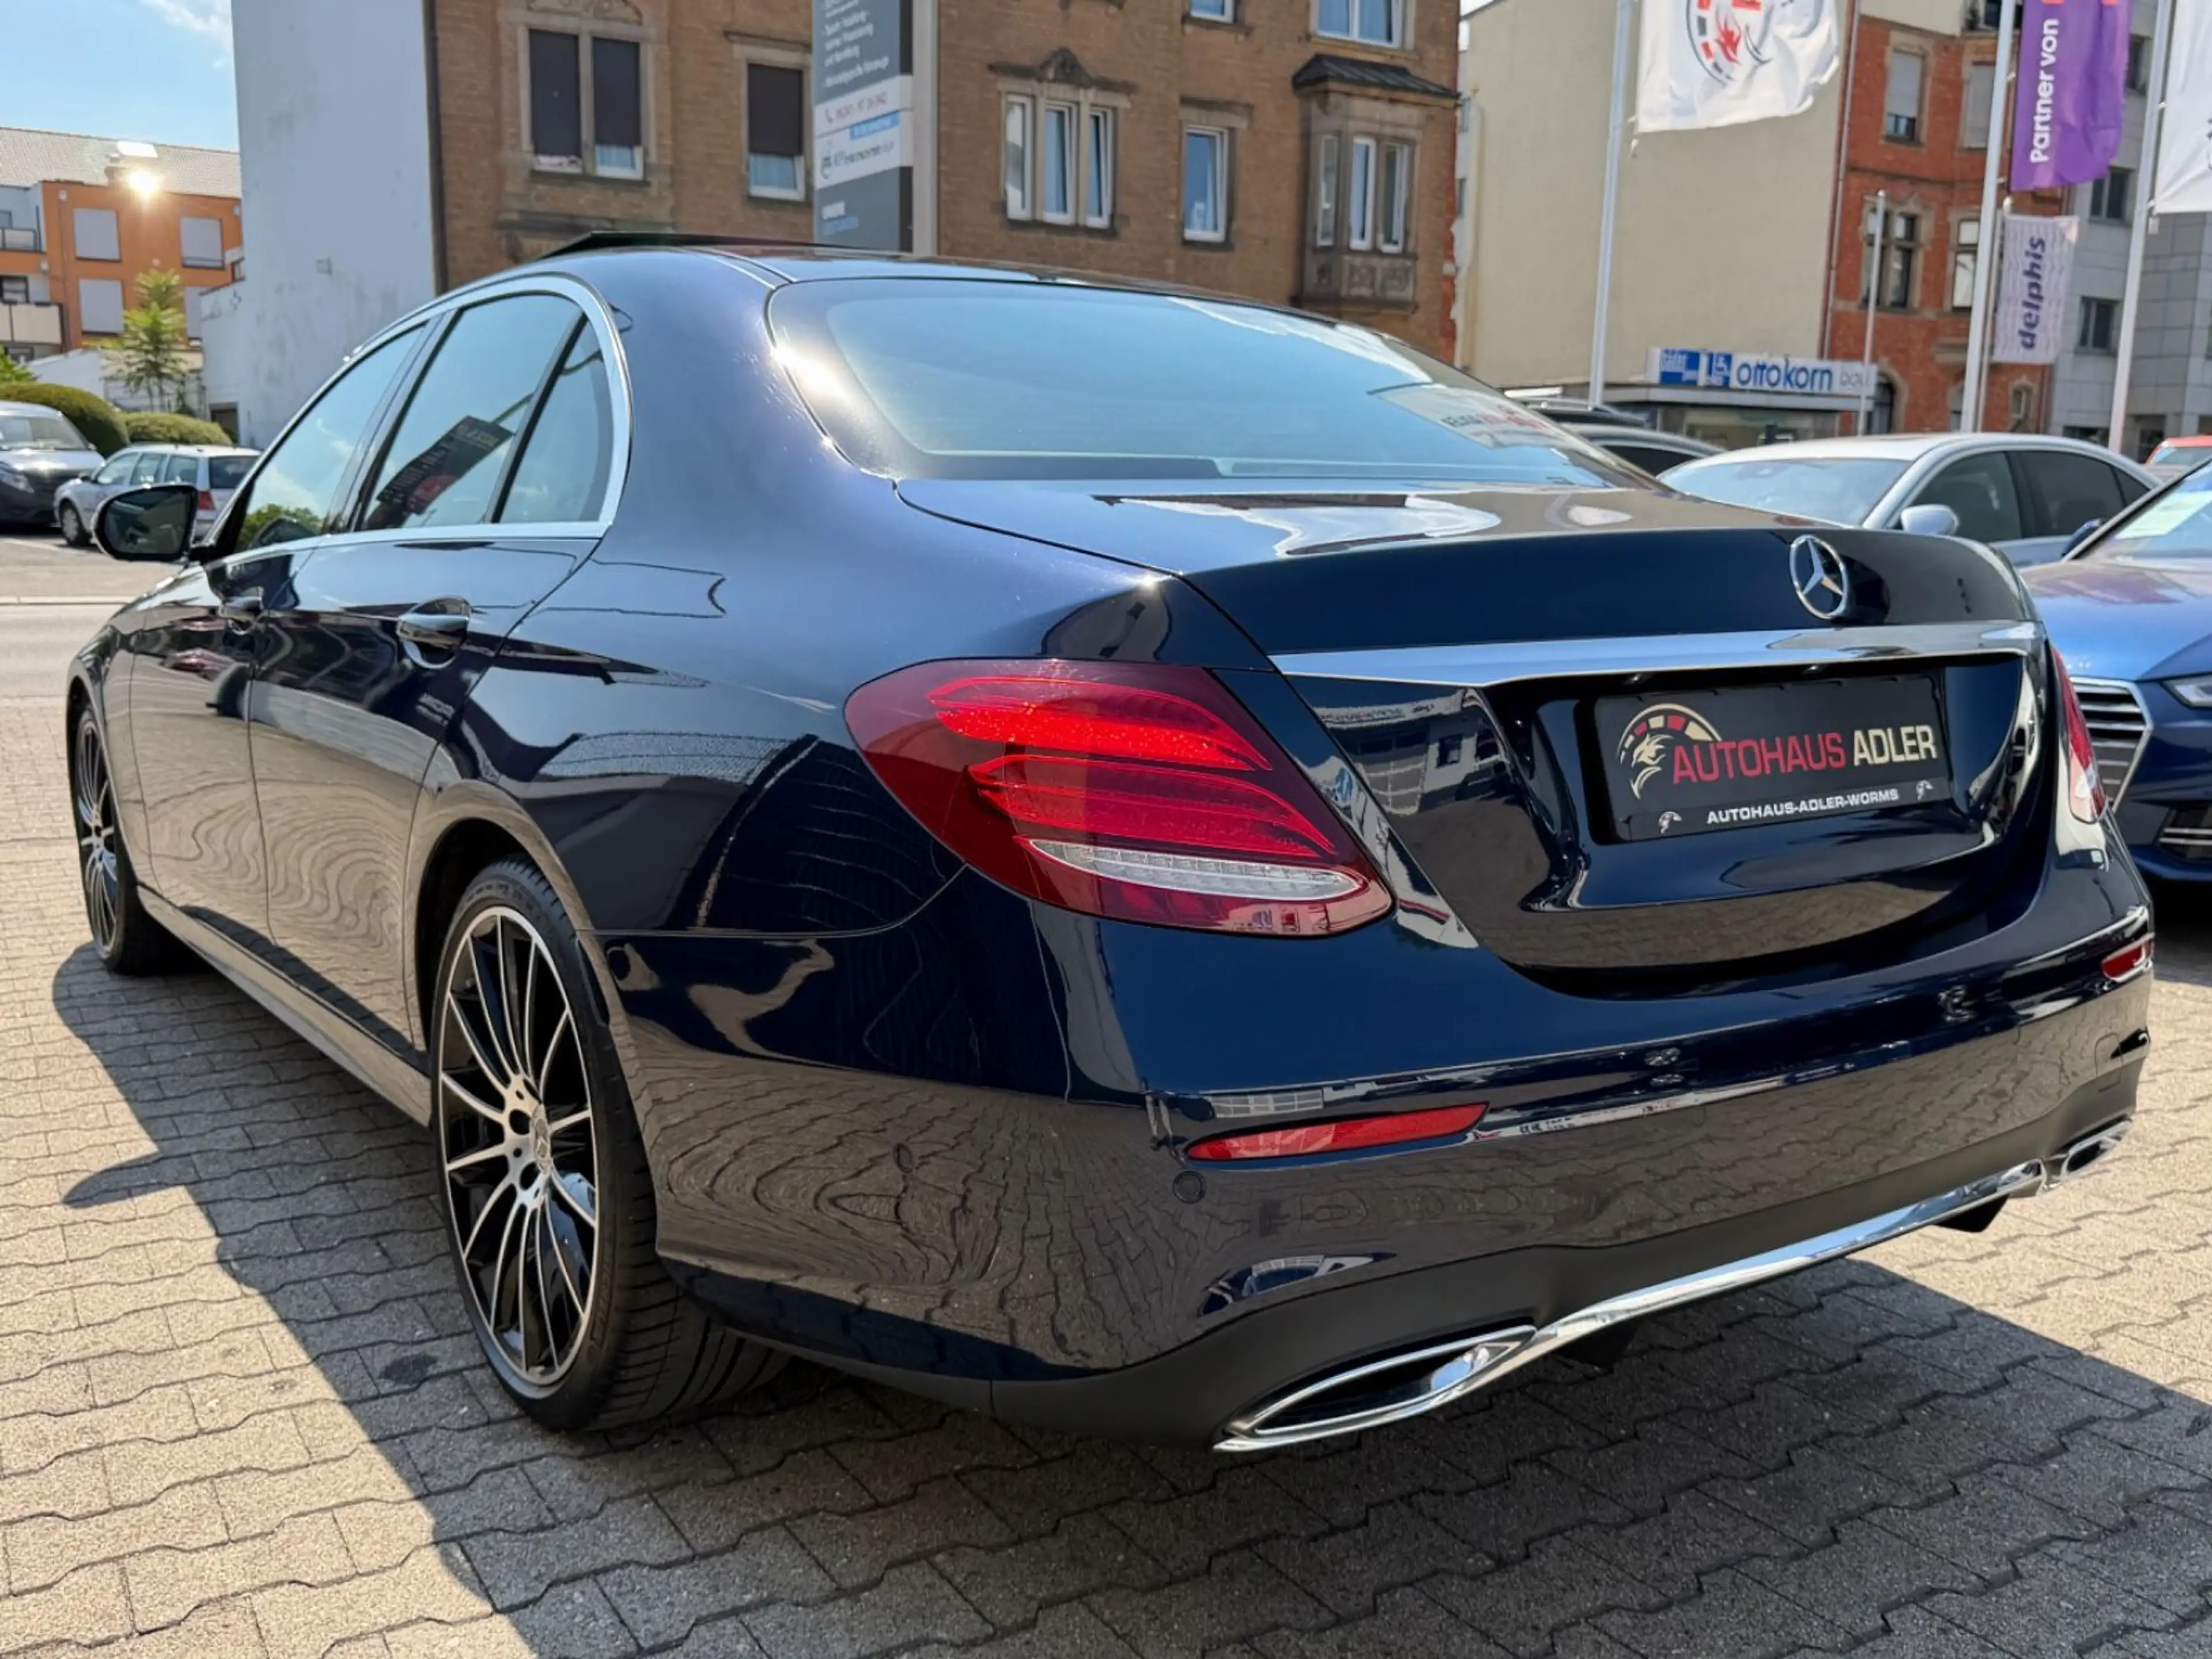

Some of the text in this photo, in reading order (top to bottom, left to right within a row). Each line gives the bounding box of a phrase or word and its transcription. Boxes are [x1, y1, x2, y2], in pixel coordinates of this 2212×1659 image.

[2029, 18, 2060, 163] Partner von
[2018, 235, 2046, 350] delphis
[1673, 725, 1938, 783] AUTOHAUS ADLER
[1707, 789, 1899, 824] AUTOHAUS-ADLER-WORMS
